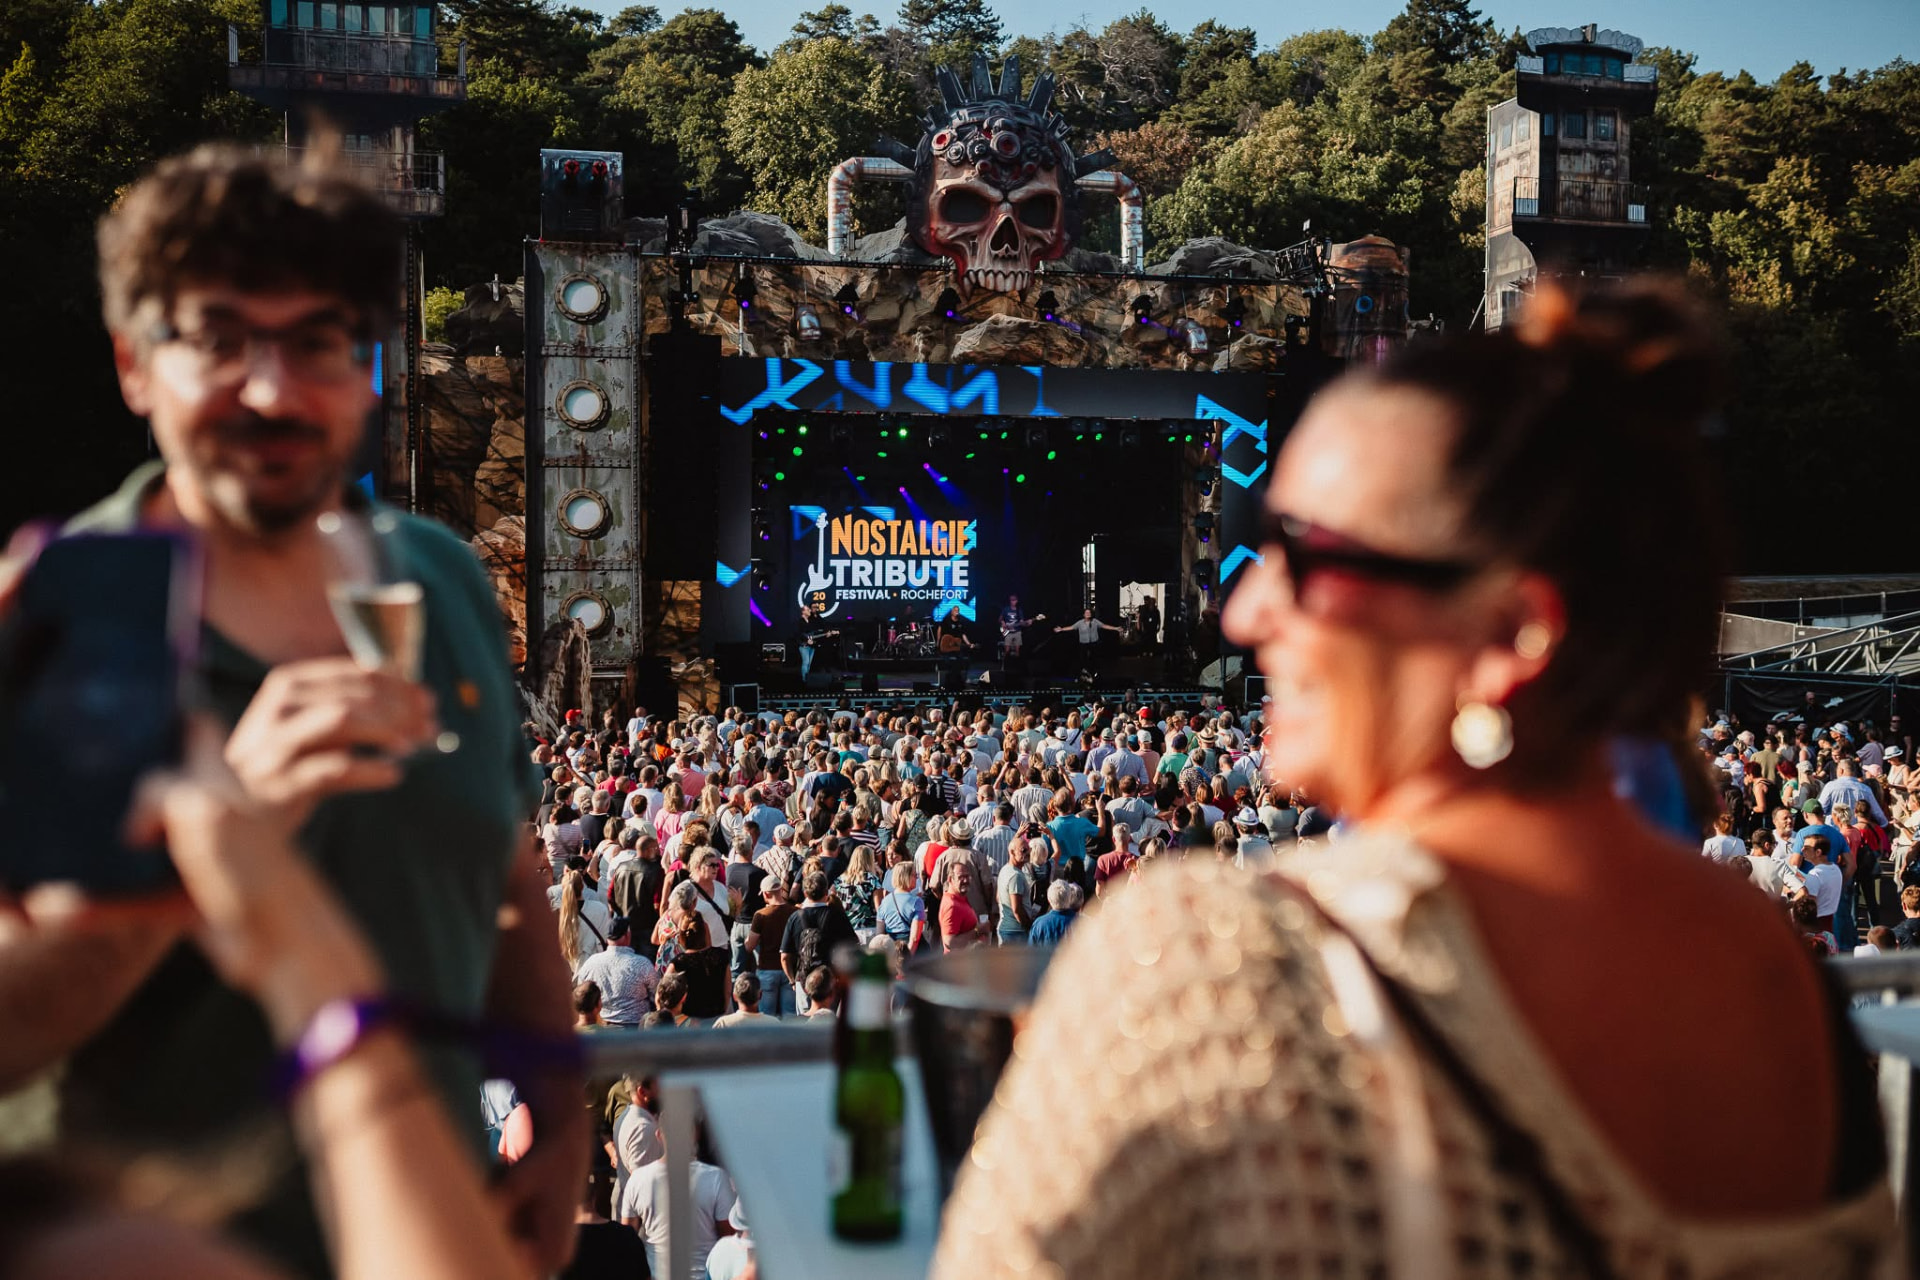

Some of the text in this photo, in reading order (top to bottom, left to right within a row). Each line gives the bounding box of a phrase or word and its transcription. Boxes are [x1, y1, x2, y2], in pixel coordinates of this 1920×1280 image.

[831, 514, 969, 558] NOSTALGIE
[829, 559, 969, 587] TRIBUTE
[812, 591, 826, 601] 20
[835, 589, 969, 600] FESTIVAL ROCHEFORT
